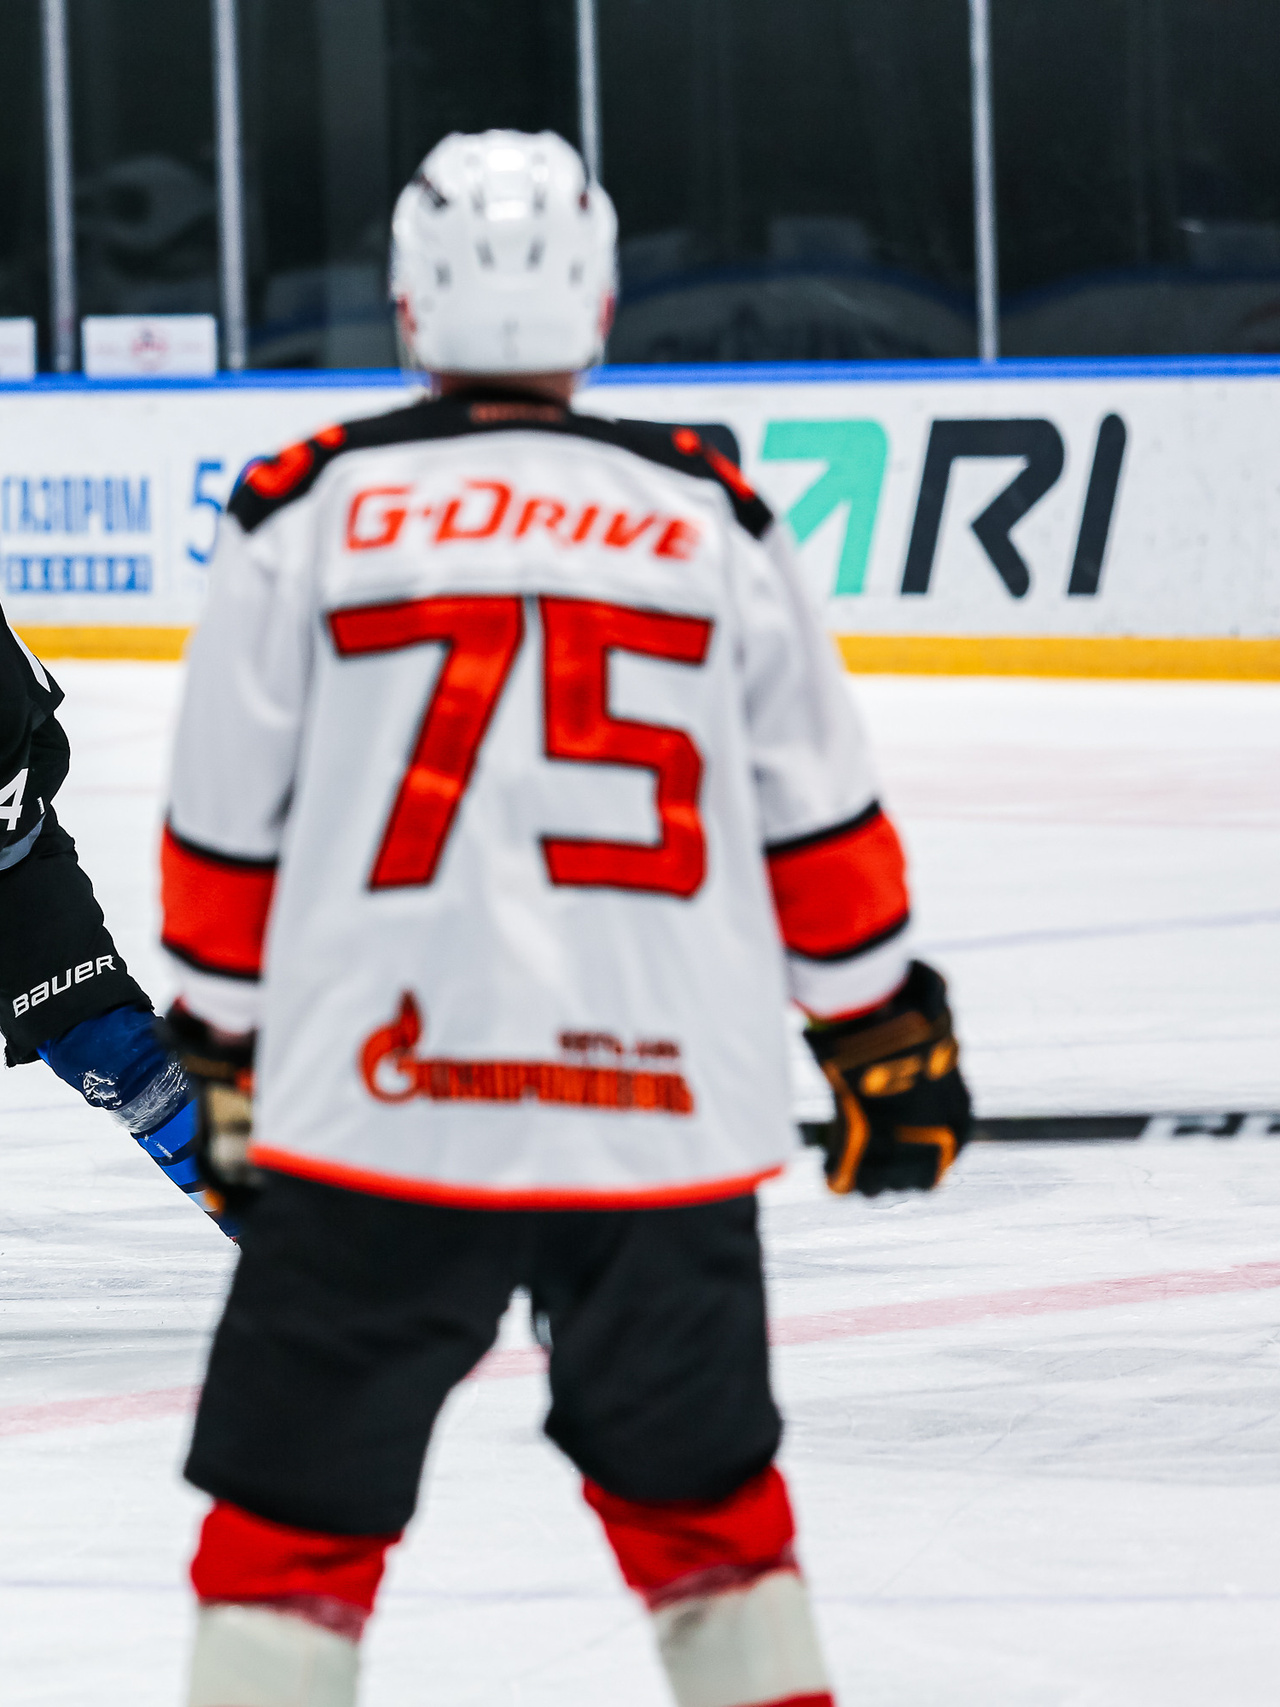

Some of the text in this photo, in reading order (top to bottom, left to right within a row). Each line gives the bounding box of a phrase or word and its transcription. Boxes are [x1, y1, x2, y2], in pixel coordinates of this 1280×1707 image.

[2, 475, 150, 534] ГАЗПРОМ
[675, 413, 1127, 599] ARI
[327, 592, 714, 901] 75
[12, 954, 117, 1018] BAUER
